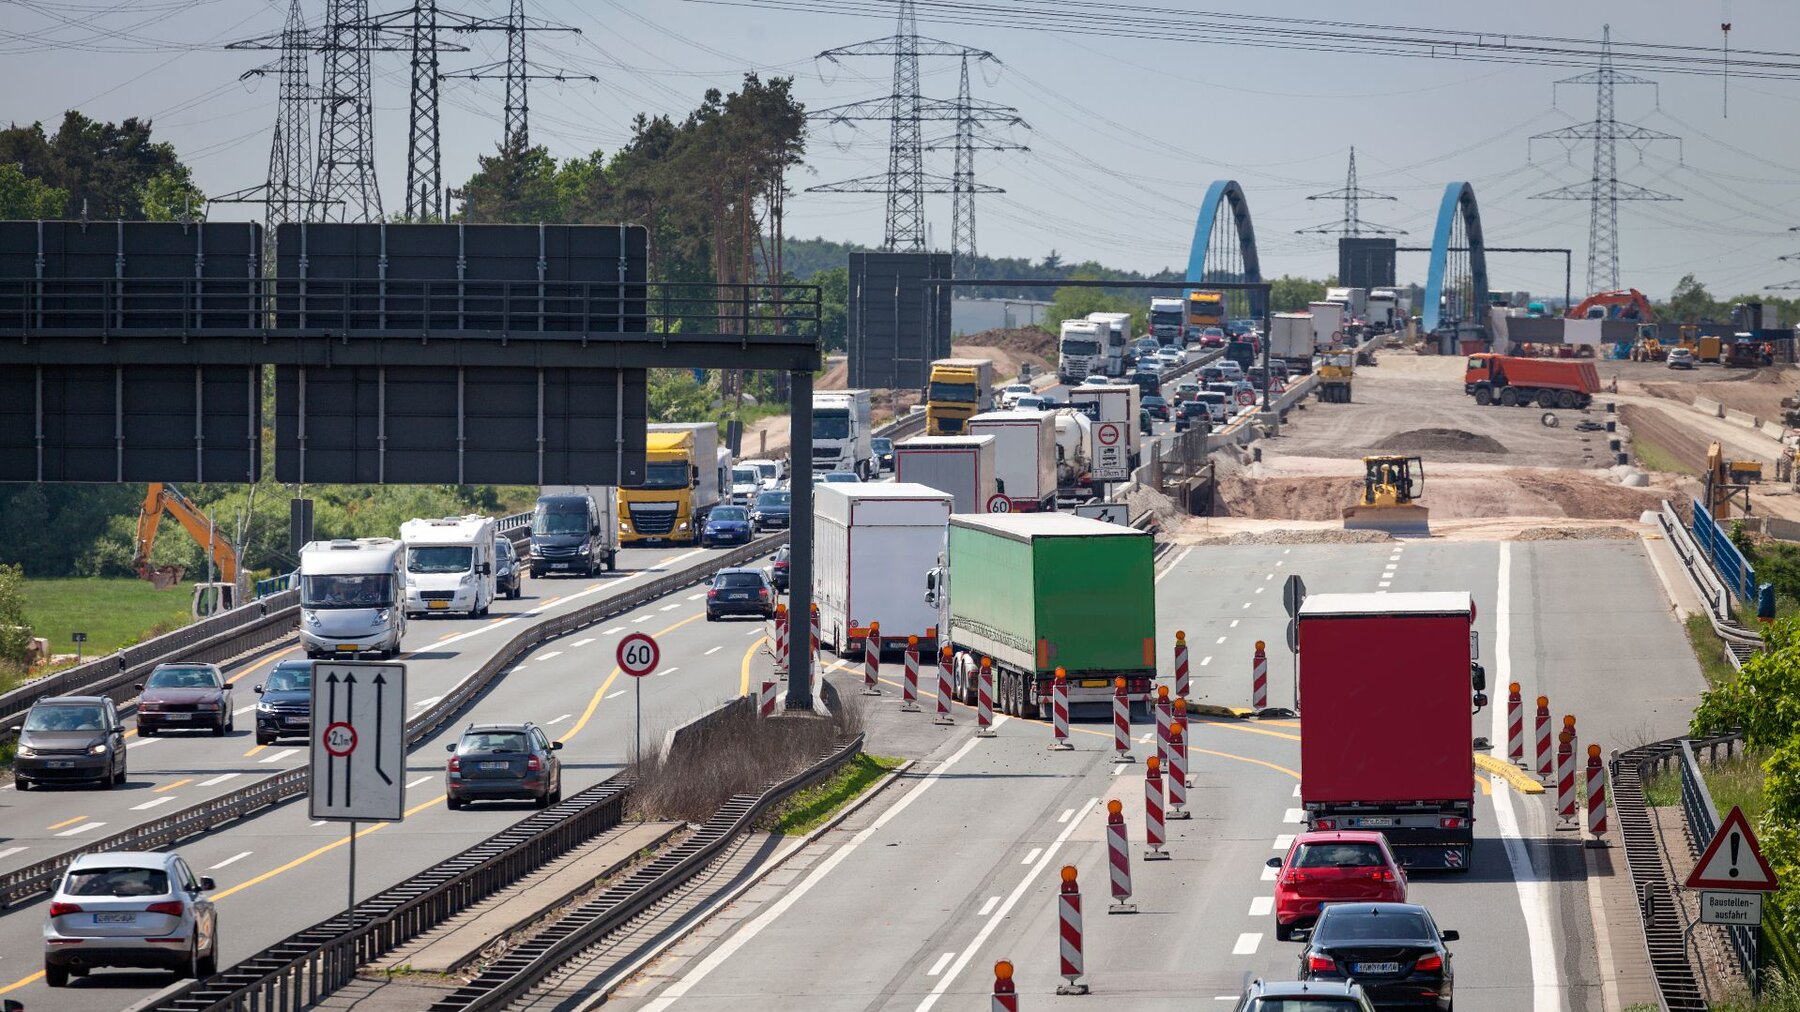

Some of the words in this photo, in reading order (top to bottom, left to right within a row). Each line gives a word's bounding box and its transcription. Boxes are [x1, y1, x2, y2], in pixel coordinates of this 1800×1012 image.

[992, 501, 1007, 513] 60
[626, 645, 650, 665] 60
[1709, 896, 1754, 907] Baustellen-
[1715, 910, 1748, 920] ausfahrt
